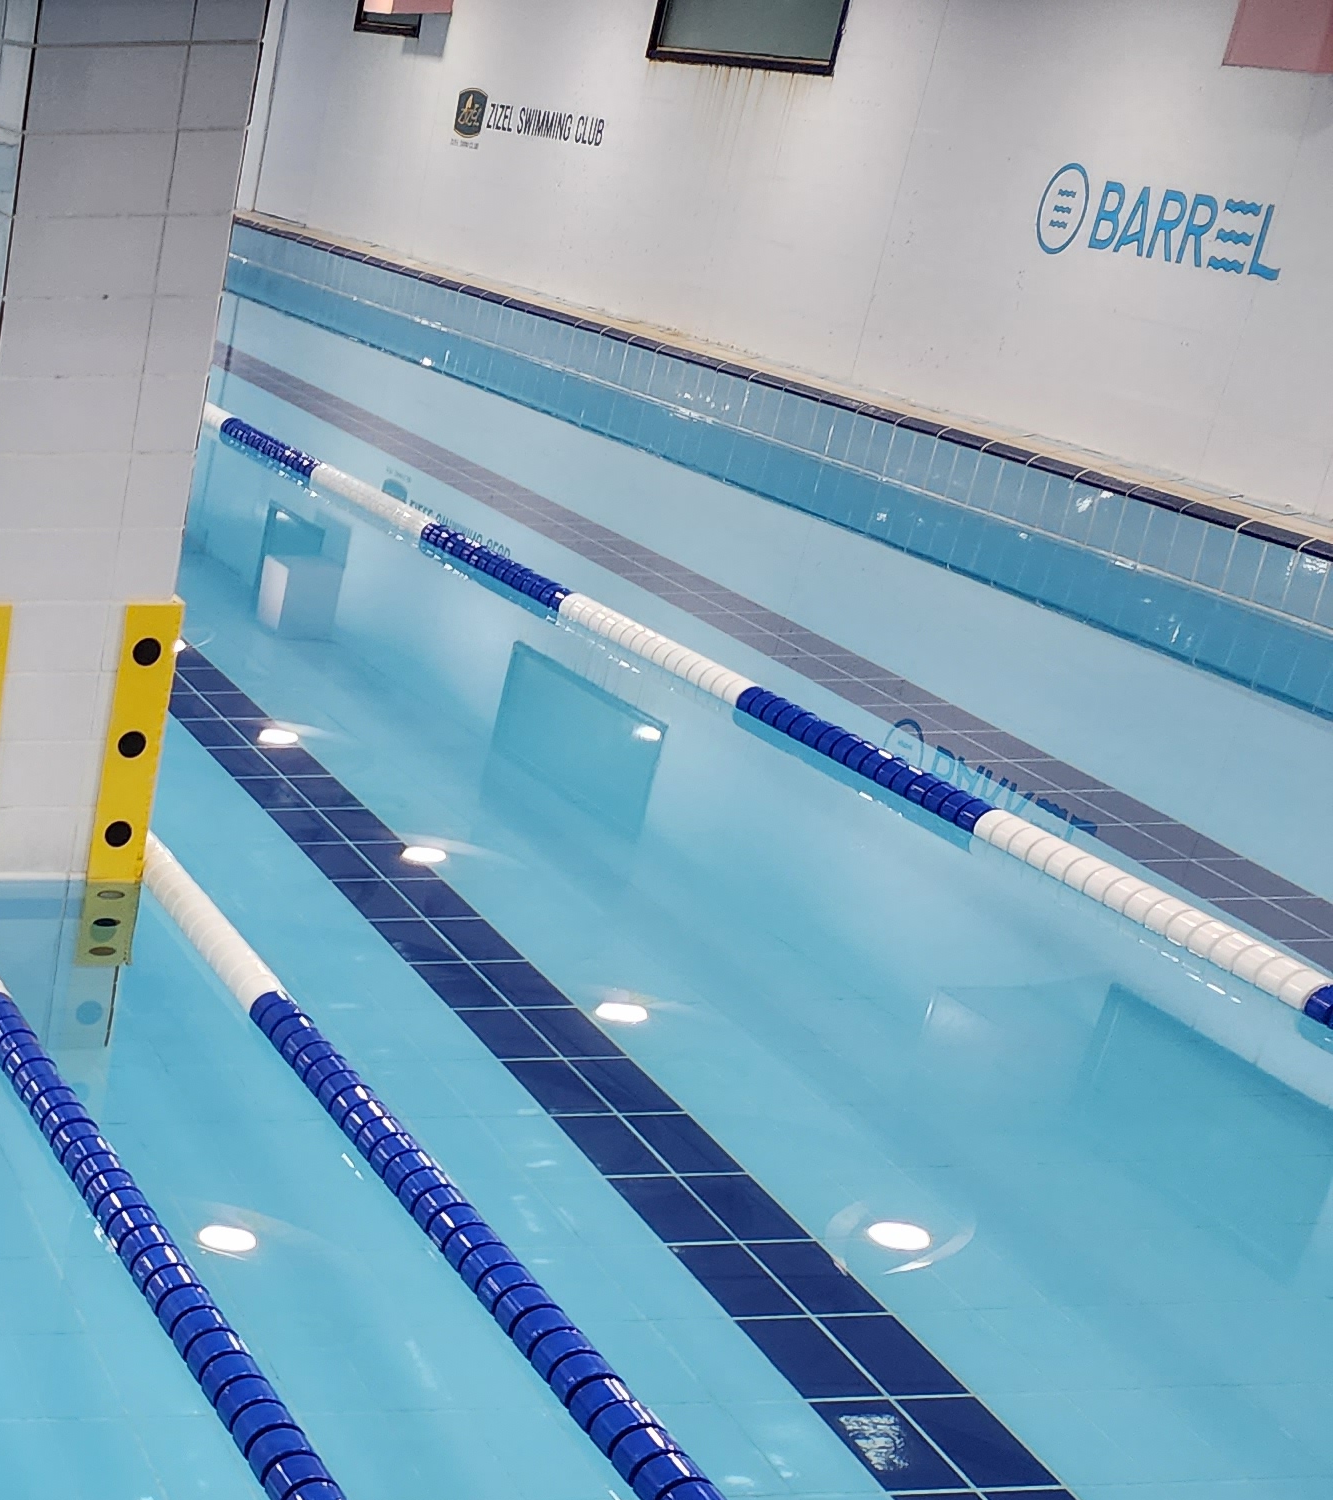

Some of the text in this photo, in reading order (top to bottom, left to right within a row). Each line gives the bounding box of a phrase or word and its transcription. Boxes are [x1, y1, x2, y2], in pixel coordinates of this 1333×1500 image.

[486, 103, 605, 146] ZIZEL SWIMMING CLUB
[1088, 180, 1281, 281] BARREL
